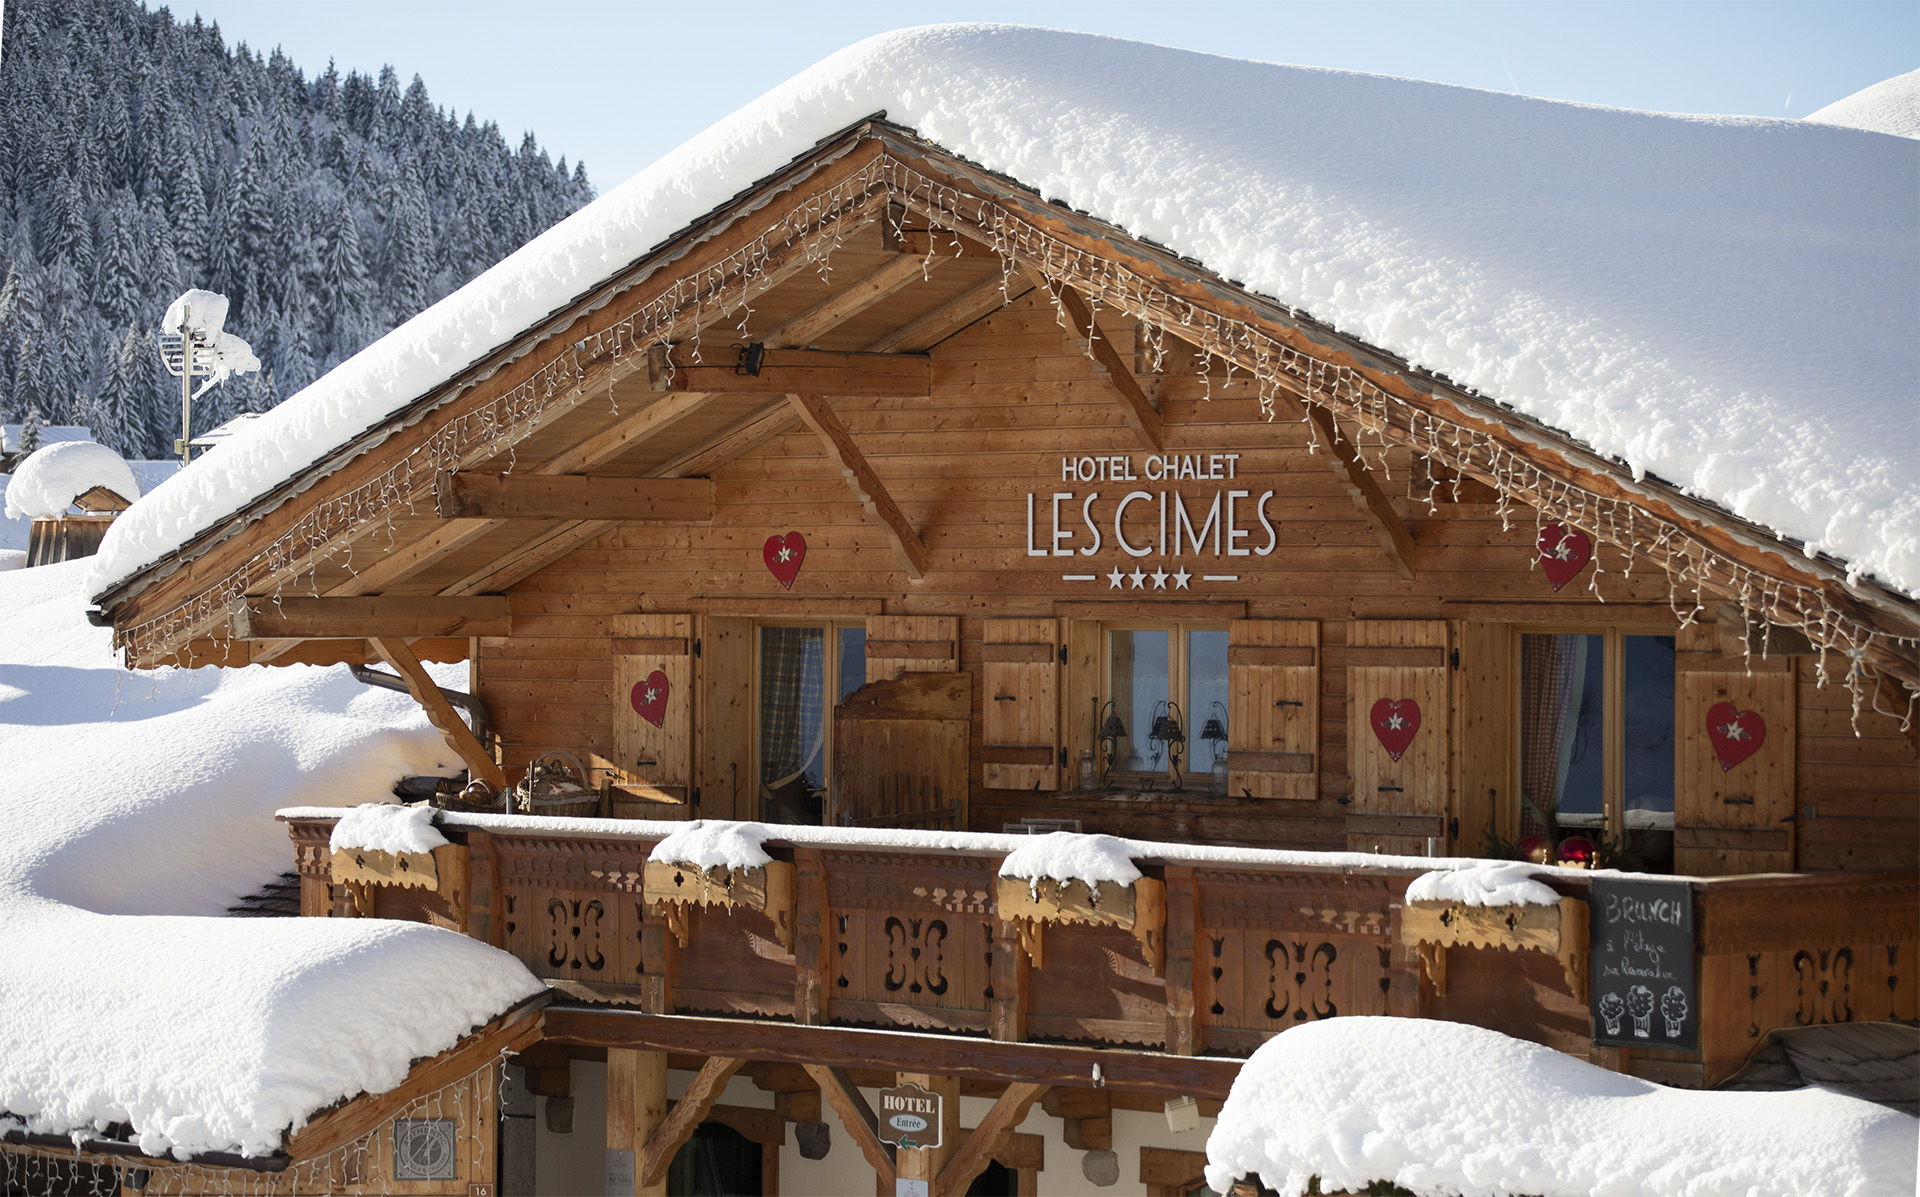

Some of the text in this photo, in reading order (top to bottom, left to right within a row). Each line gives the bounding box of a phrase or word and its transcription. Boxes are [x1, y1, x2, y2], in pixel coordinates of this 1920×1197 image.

[1062, 454, 1240, 481] HOTEL CHALET
[1027, 489, 1276, 557] LES CIMES
[1605, 893, 1682, 926] BRUNCH
[883, 1095, 935, 1114] HOTEL
[896, 1117, 921, 1128] Entrée
[476, 1187, 487, 1196] 16
